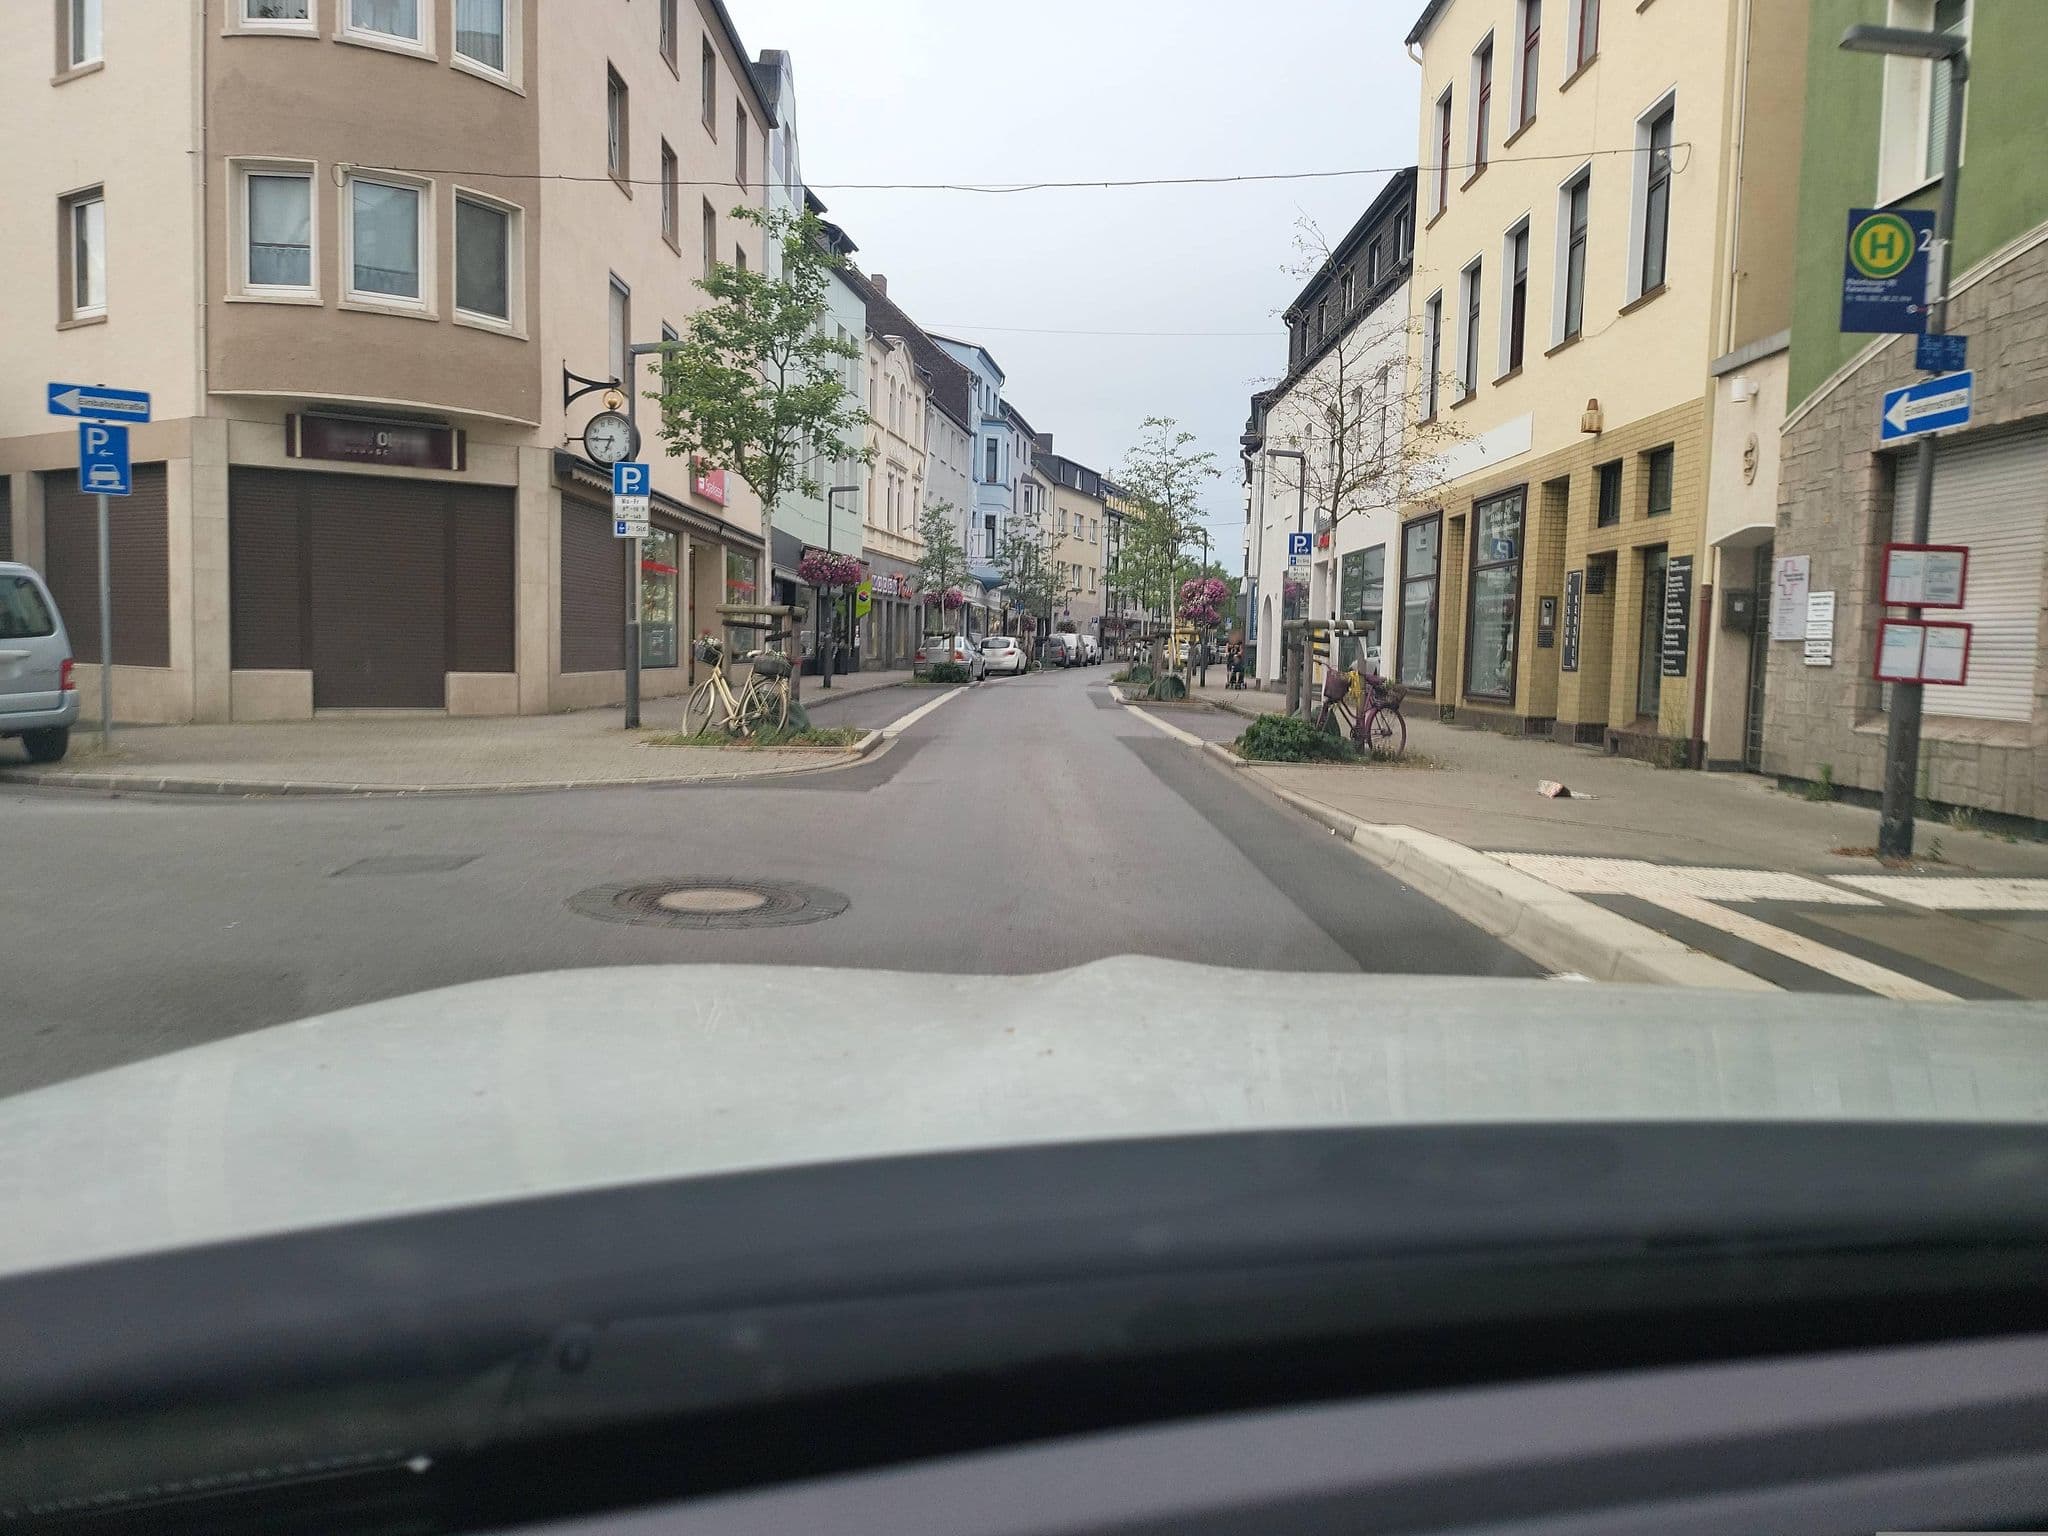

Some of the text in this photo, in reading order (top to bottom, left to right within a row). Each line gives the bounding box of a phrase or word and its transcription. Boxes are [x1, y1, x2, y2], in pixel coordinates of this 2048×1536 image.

[1870, 231, 1895, 260] H
[1918, 228, 1933, 252] 2
[86, 427, 110, 455] P
[621, 467, 642, 494] P
[1293, 535, 1307, 554] P
